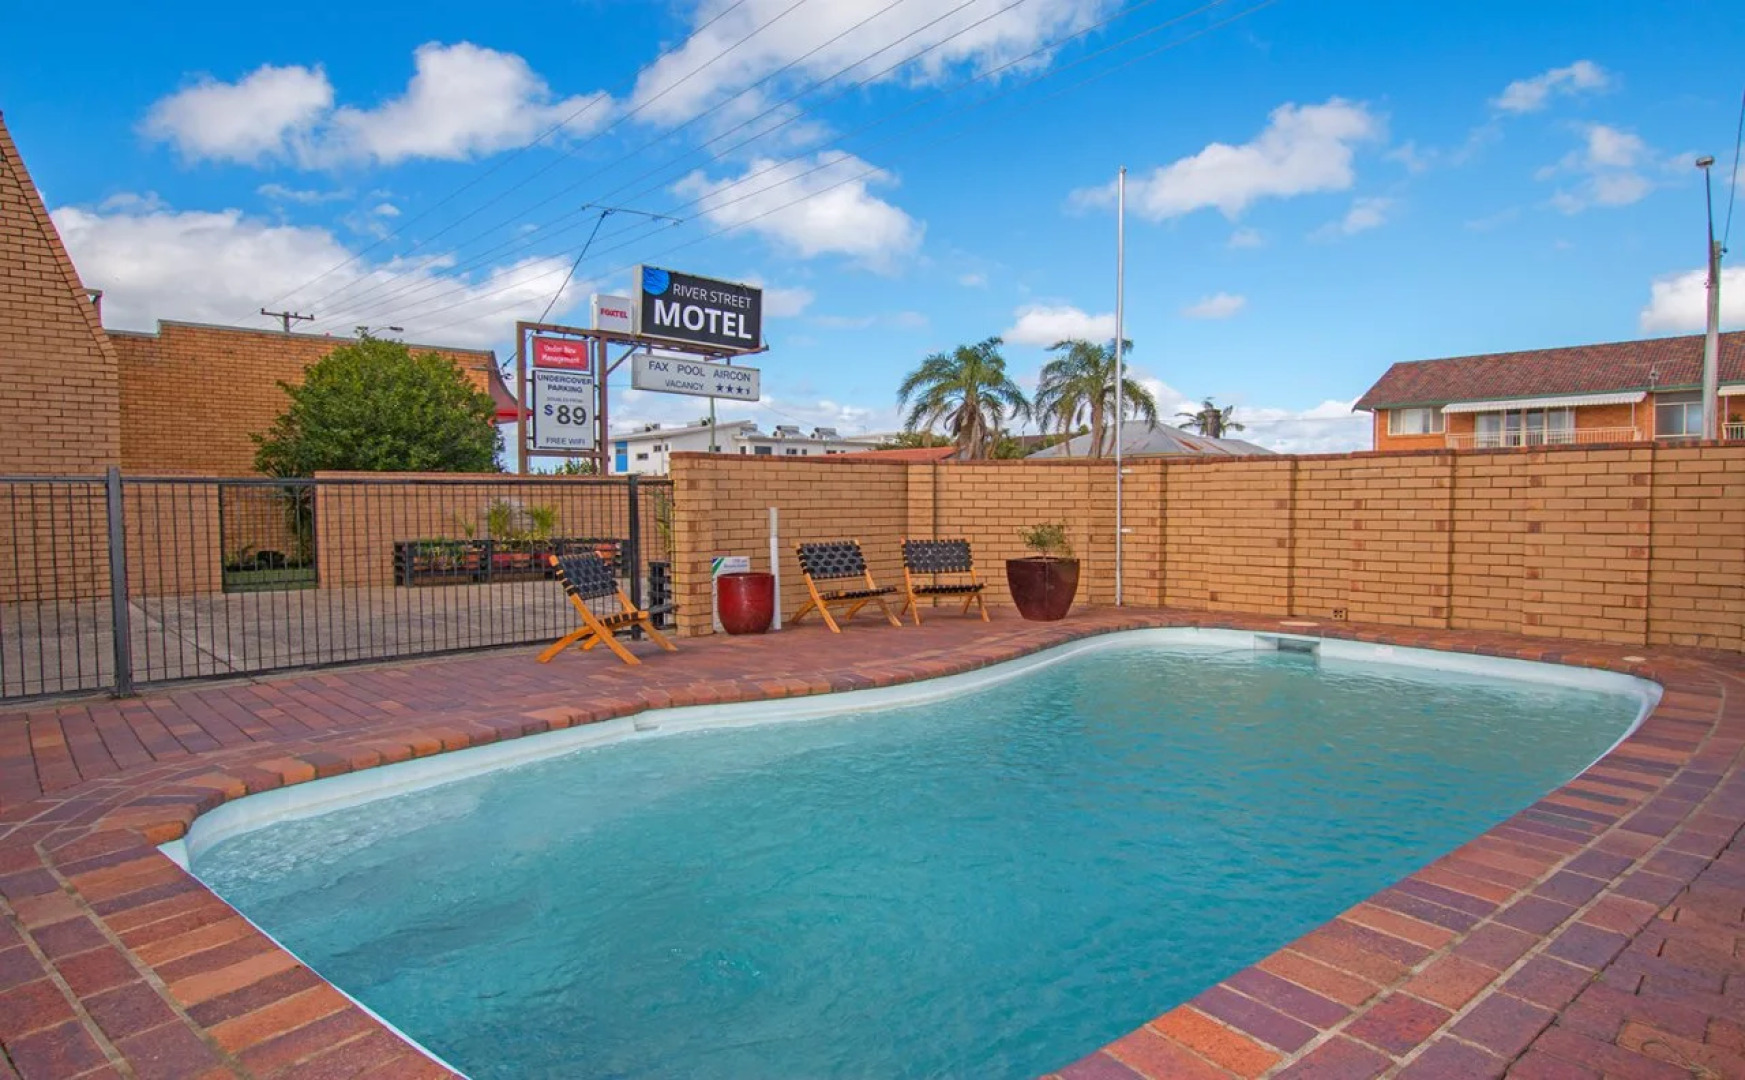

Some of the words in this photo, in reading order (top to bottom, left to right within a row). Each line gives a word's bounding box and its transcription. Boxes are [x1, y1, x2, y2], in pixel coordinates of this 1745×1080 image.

[673, 284, 707, 300] RIVER
[710, 291, 751, 309] STREET
[601, 308, 627, 318] FOXTEL
[654, 299, 752, 339] MOTEL
[649, 361, 669, 372] FAX
[677, 364, 705, 377] POOL
[713, 370, 751, 382] AIRCON
[537, 374, 592, 385] UNDERCOVER
[547, 384, 582, 393] PARKING
[665, 380, 704, 391] VACANCY
[546, 437, 567, 445] FREE
